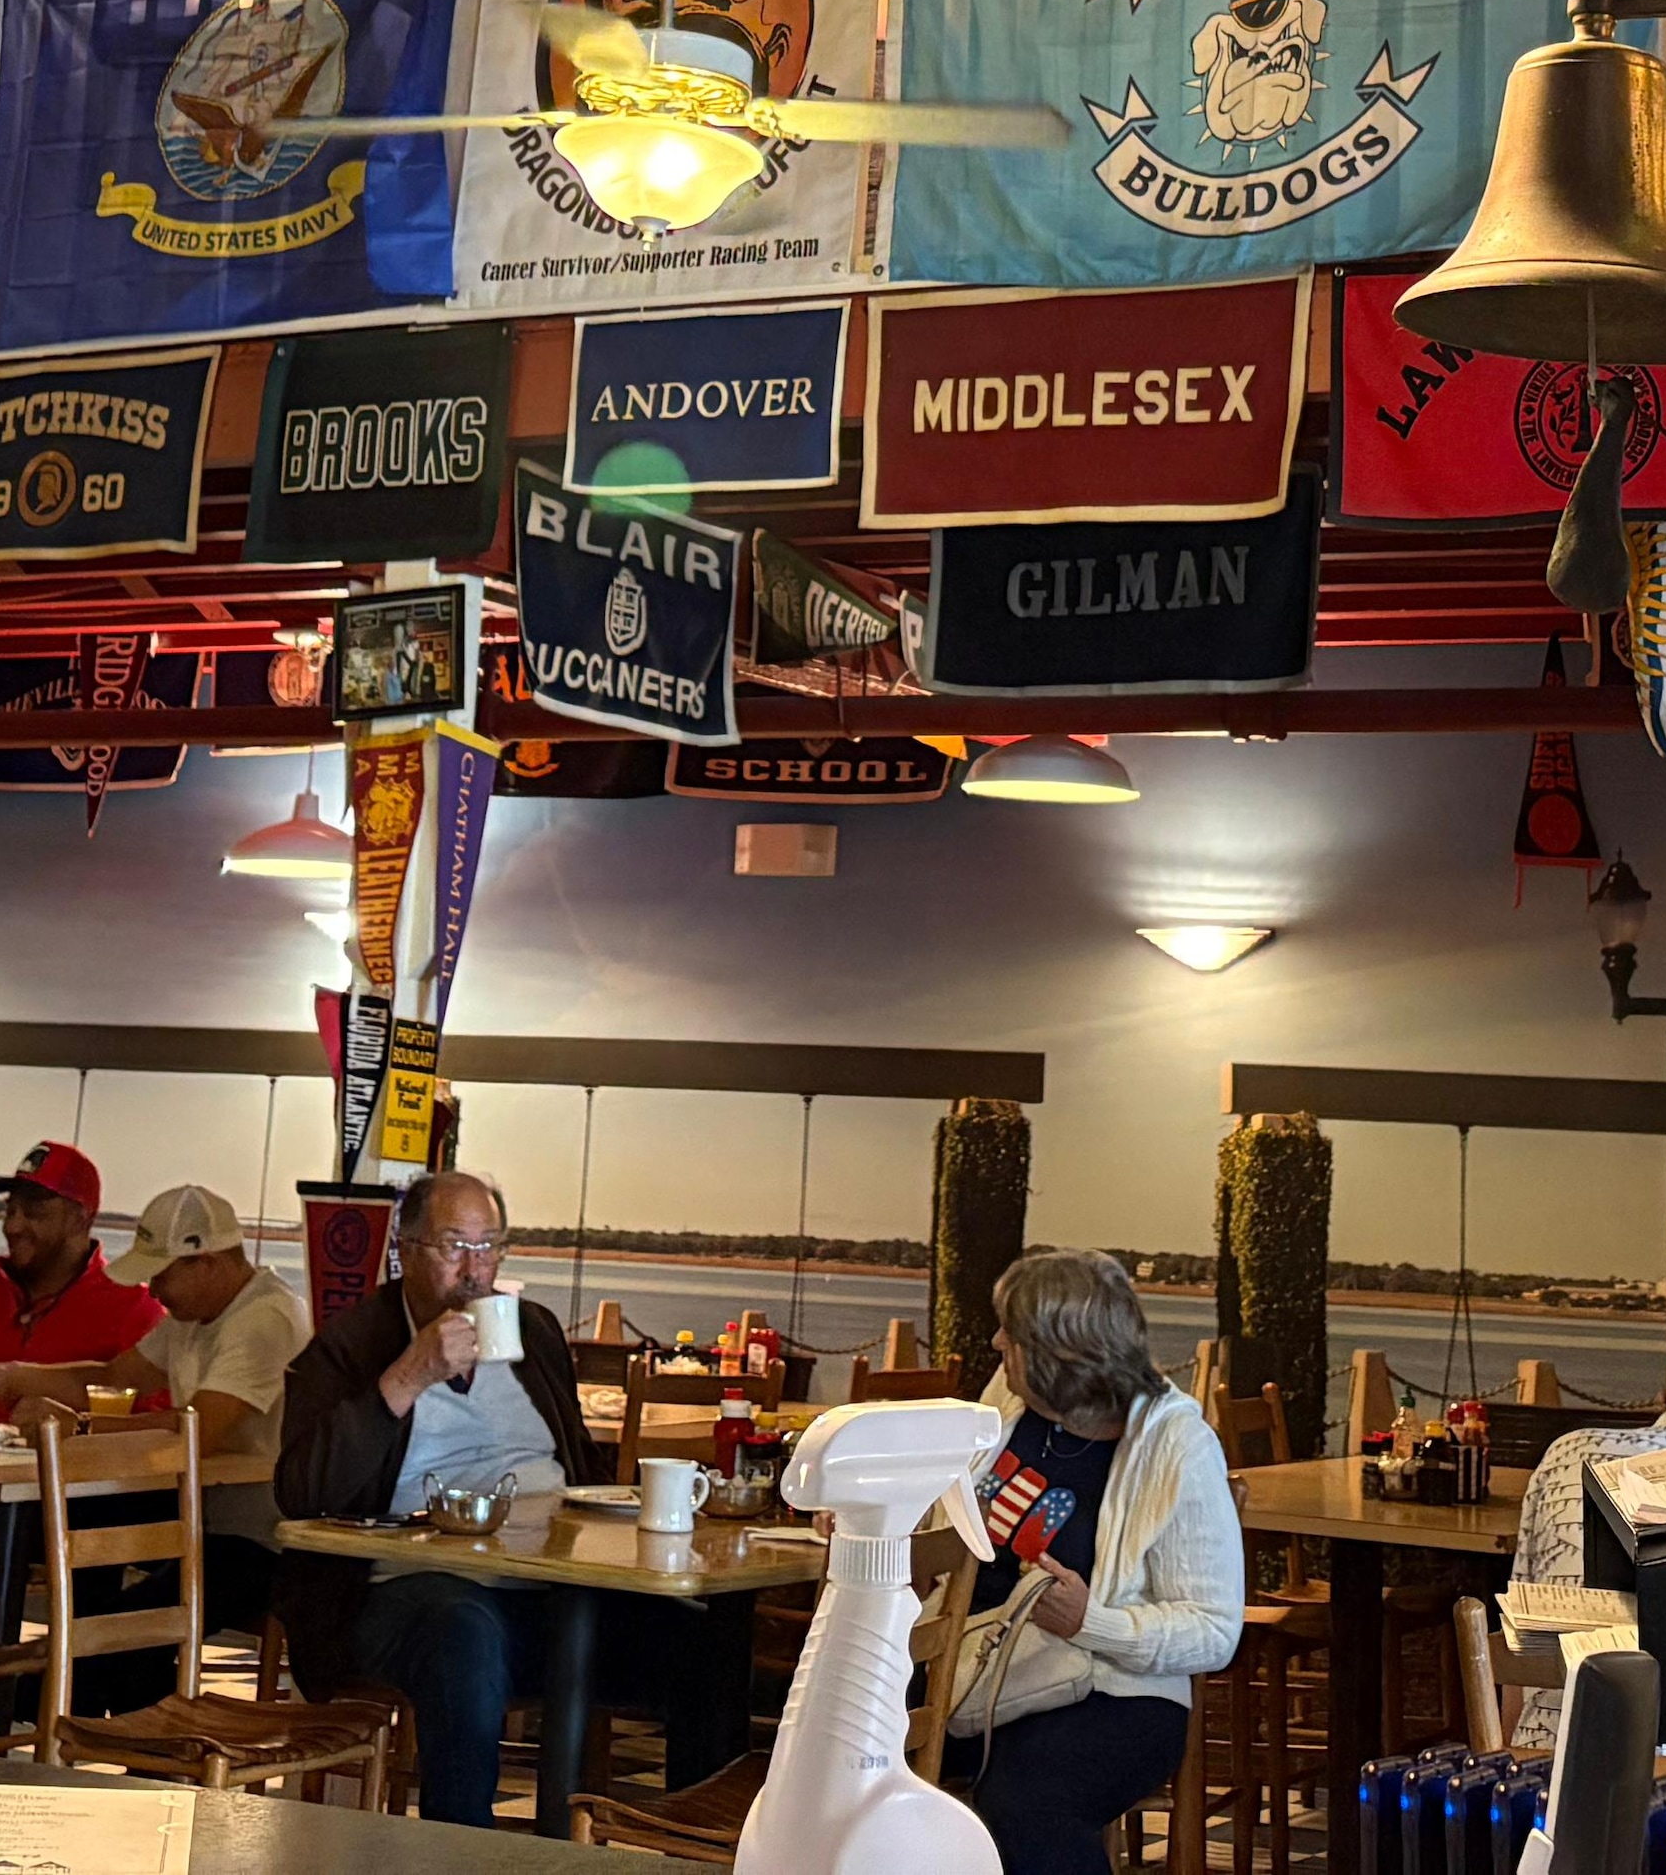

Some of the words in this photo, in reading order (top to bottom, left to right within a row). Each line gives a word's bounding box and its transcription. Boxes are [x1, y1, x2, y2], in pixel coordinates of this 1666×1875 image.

[1118, 123, 1392, 221] BULLDOGS
[142, 219, 200, 253] UNITED
[204, 224, 278, 252] STATES
[283, 204, 341, 245] NAVY
[481, 261, 536, 282] Cancer
[710, 242, 770, 269] Racing
[774, 237, 819, 260] Team
[591, 377, 816, 423] ANDOVER
[913, 365, 1257, 435] MIDDLESEX
[280, 395, 488, 494] BROOKS
[81, 473, 125, 514] 60
[526, 489, 723, 589] BLAIR
[805, 580, 889, 648] DEERFIELD
[1006, 546, 1250, 620] GILMAN
[703, 758, 928, 783] SCHOOL
[450, 752, 475, 897] CHATHAM
[441, 906, 461, 983] HALL
[347, 1004, 386, 1070] FLORIDA
